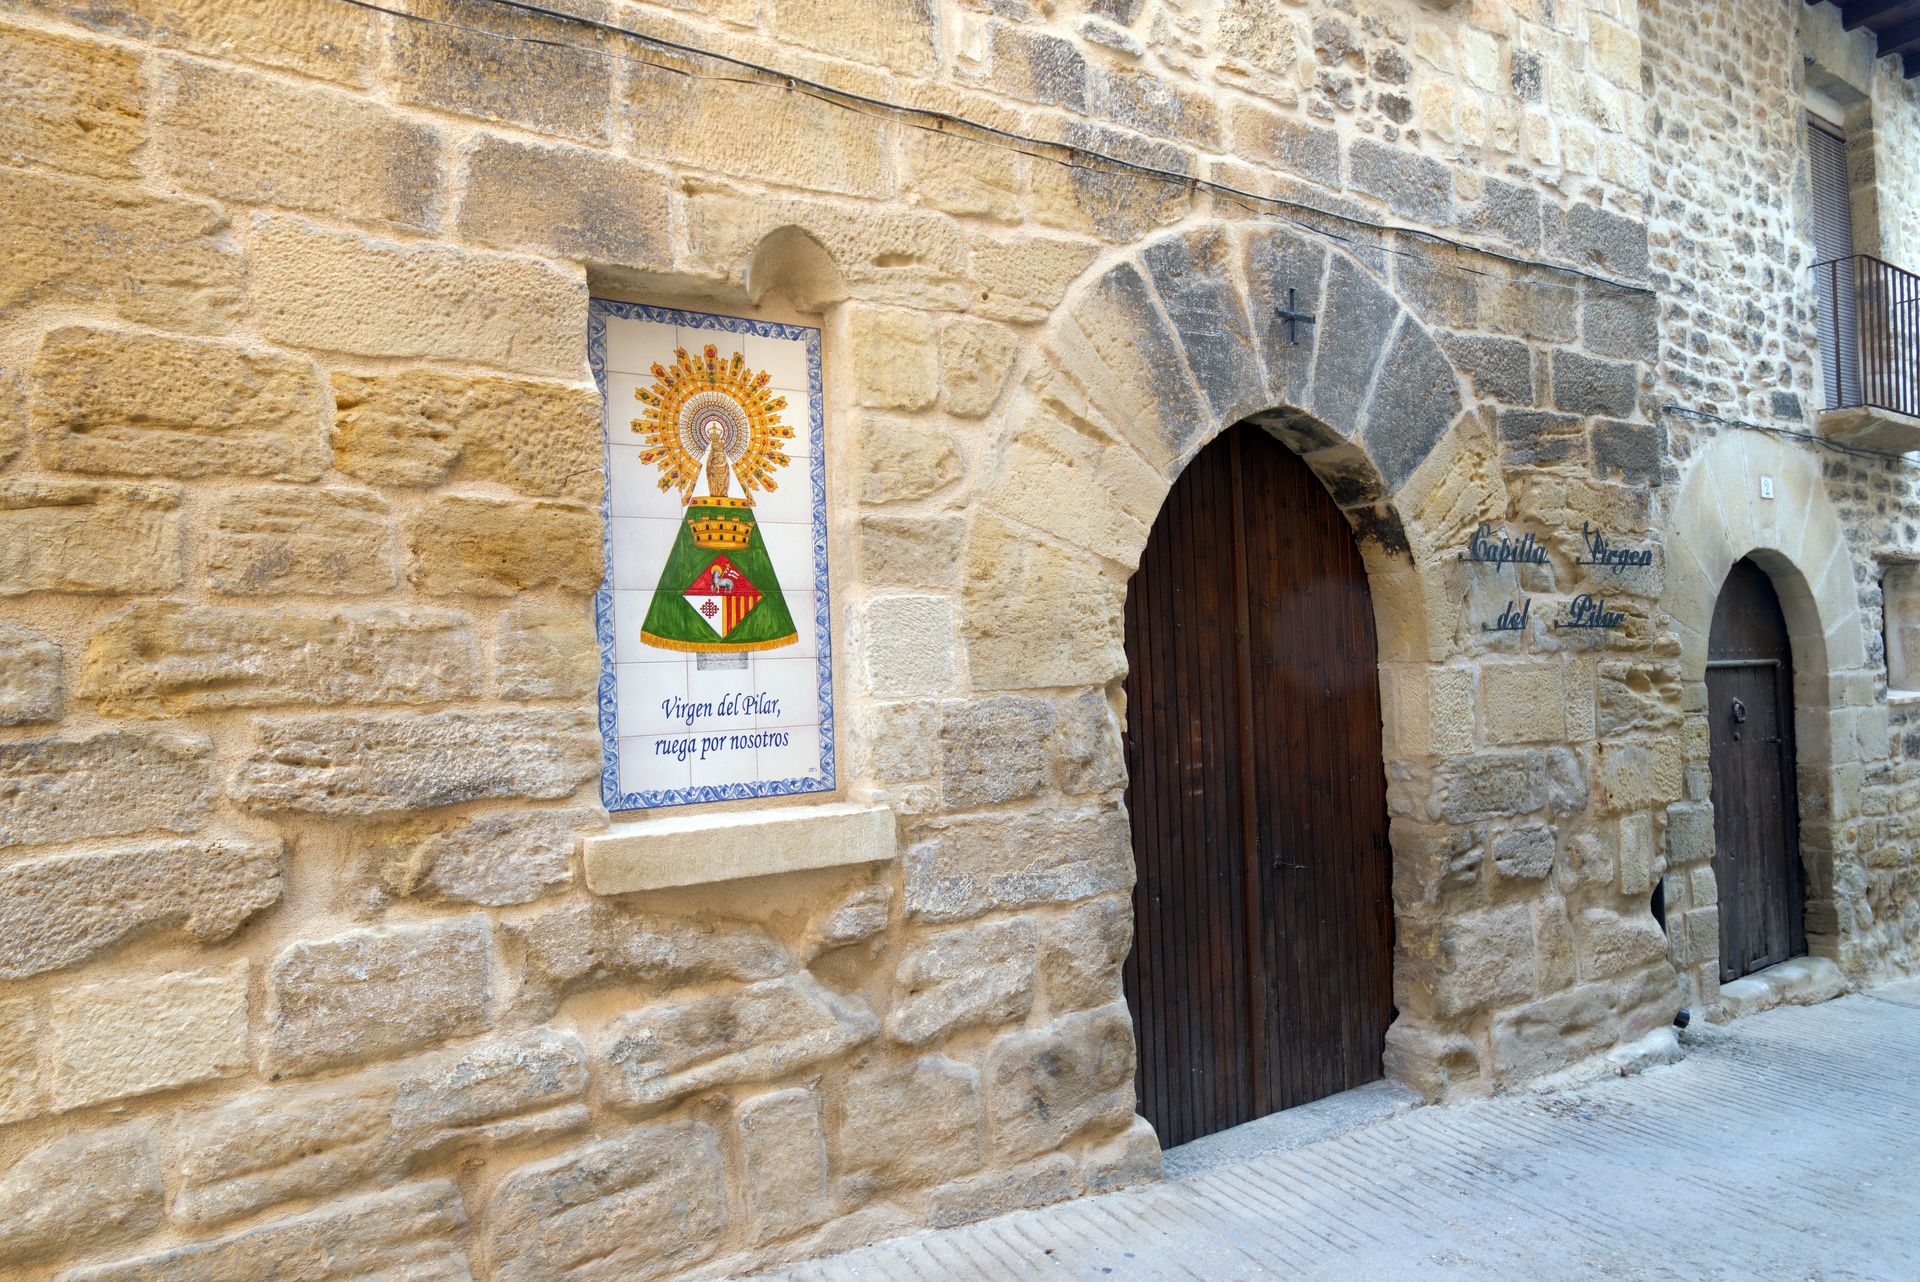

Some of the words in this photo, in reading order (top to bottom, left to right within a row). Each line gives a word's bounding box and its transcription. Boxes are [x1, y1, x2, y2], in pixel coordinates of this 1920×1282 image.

[1763, 479, 1770, 496] 2
[1471, 523, 1549, 573] Capilla
[1583, 520, 1653, 575] Virgen
[1497, 598, 1531, 629] del
[1567, 593, 1628, 628] Pilar
[661, 695, 713, 726] Virgen
[717, 692, 742, 717] del
[742, 691, 782, 718] Pilar,
[654, 736, 697, 762] ruega
[700, 735, 727, 760] por
[730, 731, 789, 750] nosotros
